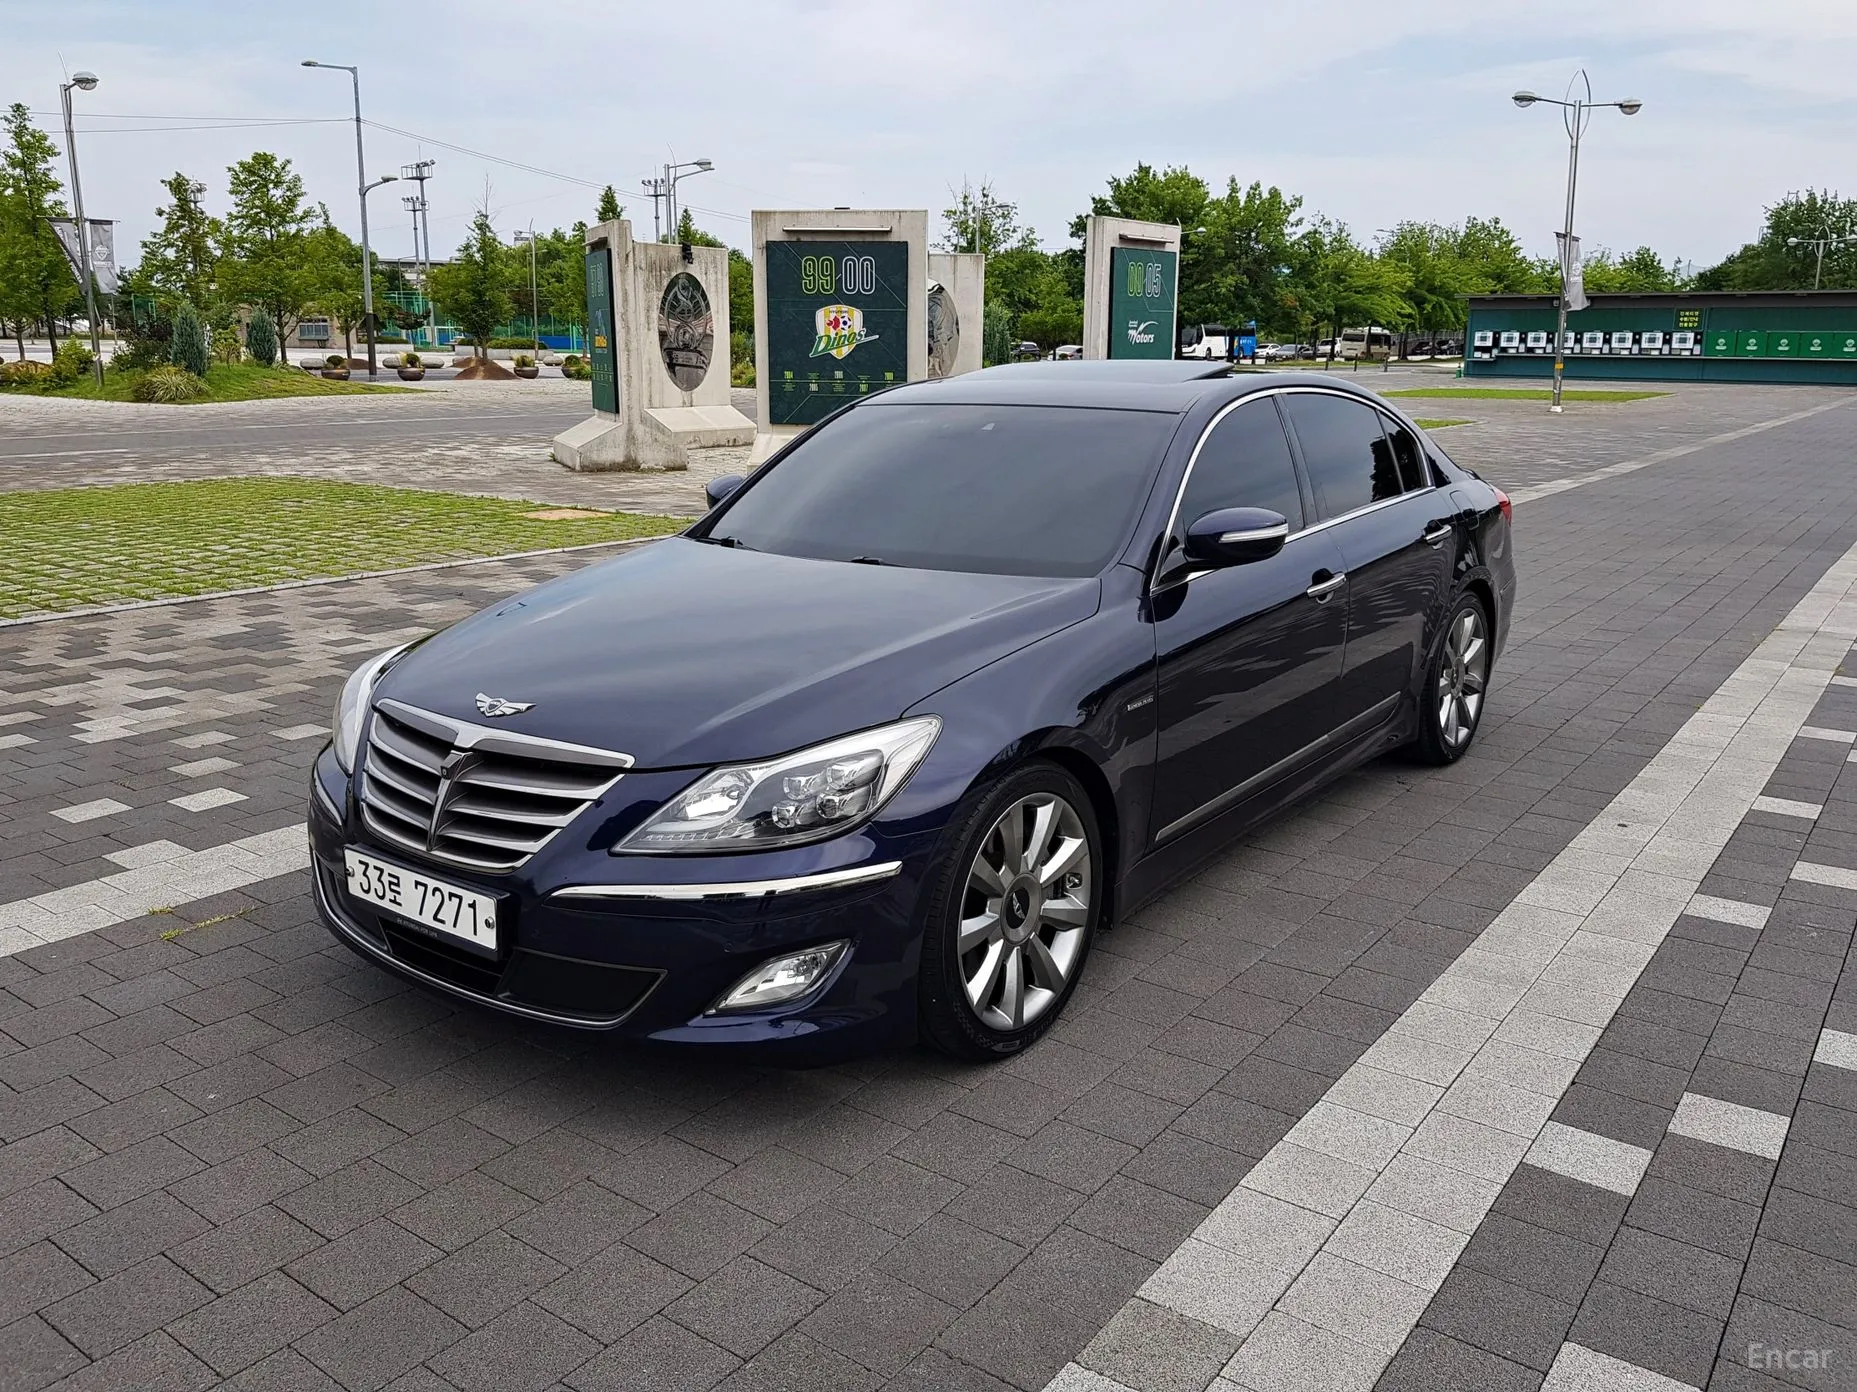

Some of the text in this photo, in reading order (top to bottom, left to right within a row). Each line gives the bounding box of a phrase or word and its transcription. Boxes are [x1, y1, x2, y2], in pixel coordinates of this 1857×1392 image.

[809, 327, 880, 358] Dinos
[1128, 323, 1156, 345] Motors
[358, 859, 478, 936] 33로 7271
